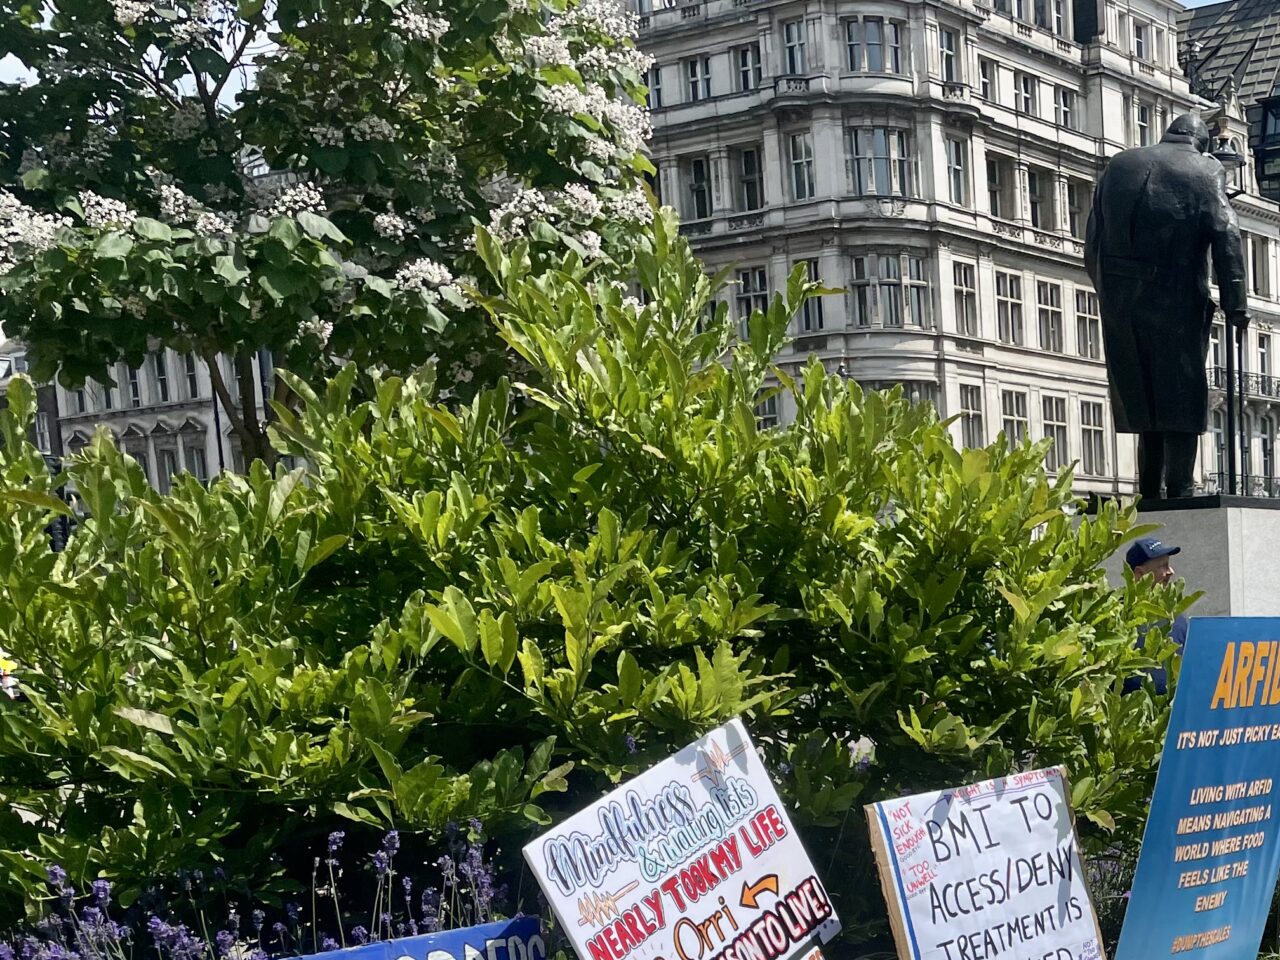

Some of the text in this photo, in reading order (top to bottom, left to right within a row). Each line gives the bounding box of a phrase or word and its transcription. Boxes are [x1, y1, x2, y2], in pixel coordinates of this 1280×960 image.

[1177, 731, 1197, 750] IT'S
[1197, 729, 1220, 749] NOT
[1219, 727, 1244, 747] JUST
[1244, 724, 1271, 744] PICKY
[713, 777, 755, 823] lists
[1189, 778, 1273, 806] LIVING WITH ARFID
[894, 821, 913, 840] SICK
[926, 793, 1051, 862] BMI TO
[1176, 804, 1271, 835] MEANS NAVIGATING A
[547, 783, 697, 892] Mindfulness
[1174, 831, 1265, 863] WORLD WHERE FOOD
[660, 857, 715, 912] TOOK
[712, 834, 742, 883] MY
[741, 806, 787, 857] LIFE
[1178, 860, 1249, 889] FEELS LIKE THE
[929, 844, 1074, 925] ACCESS/DENY
[1064, 897, 1083, 923] IS
[1194, 890, 1228, 912] ENEMY
[755, 914, 787, 955] TO
[1171, 924, 1232, 954] #DUMPTHESCALES
